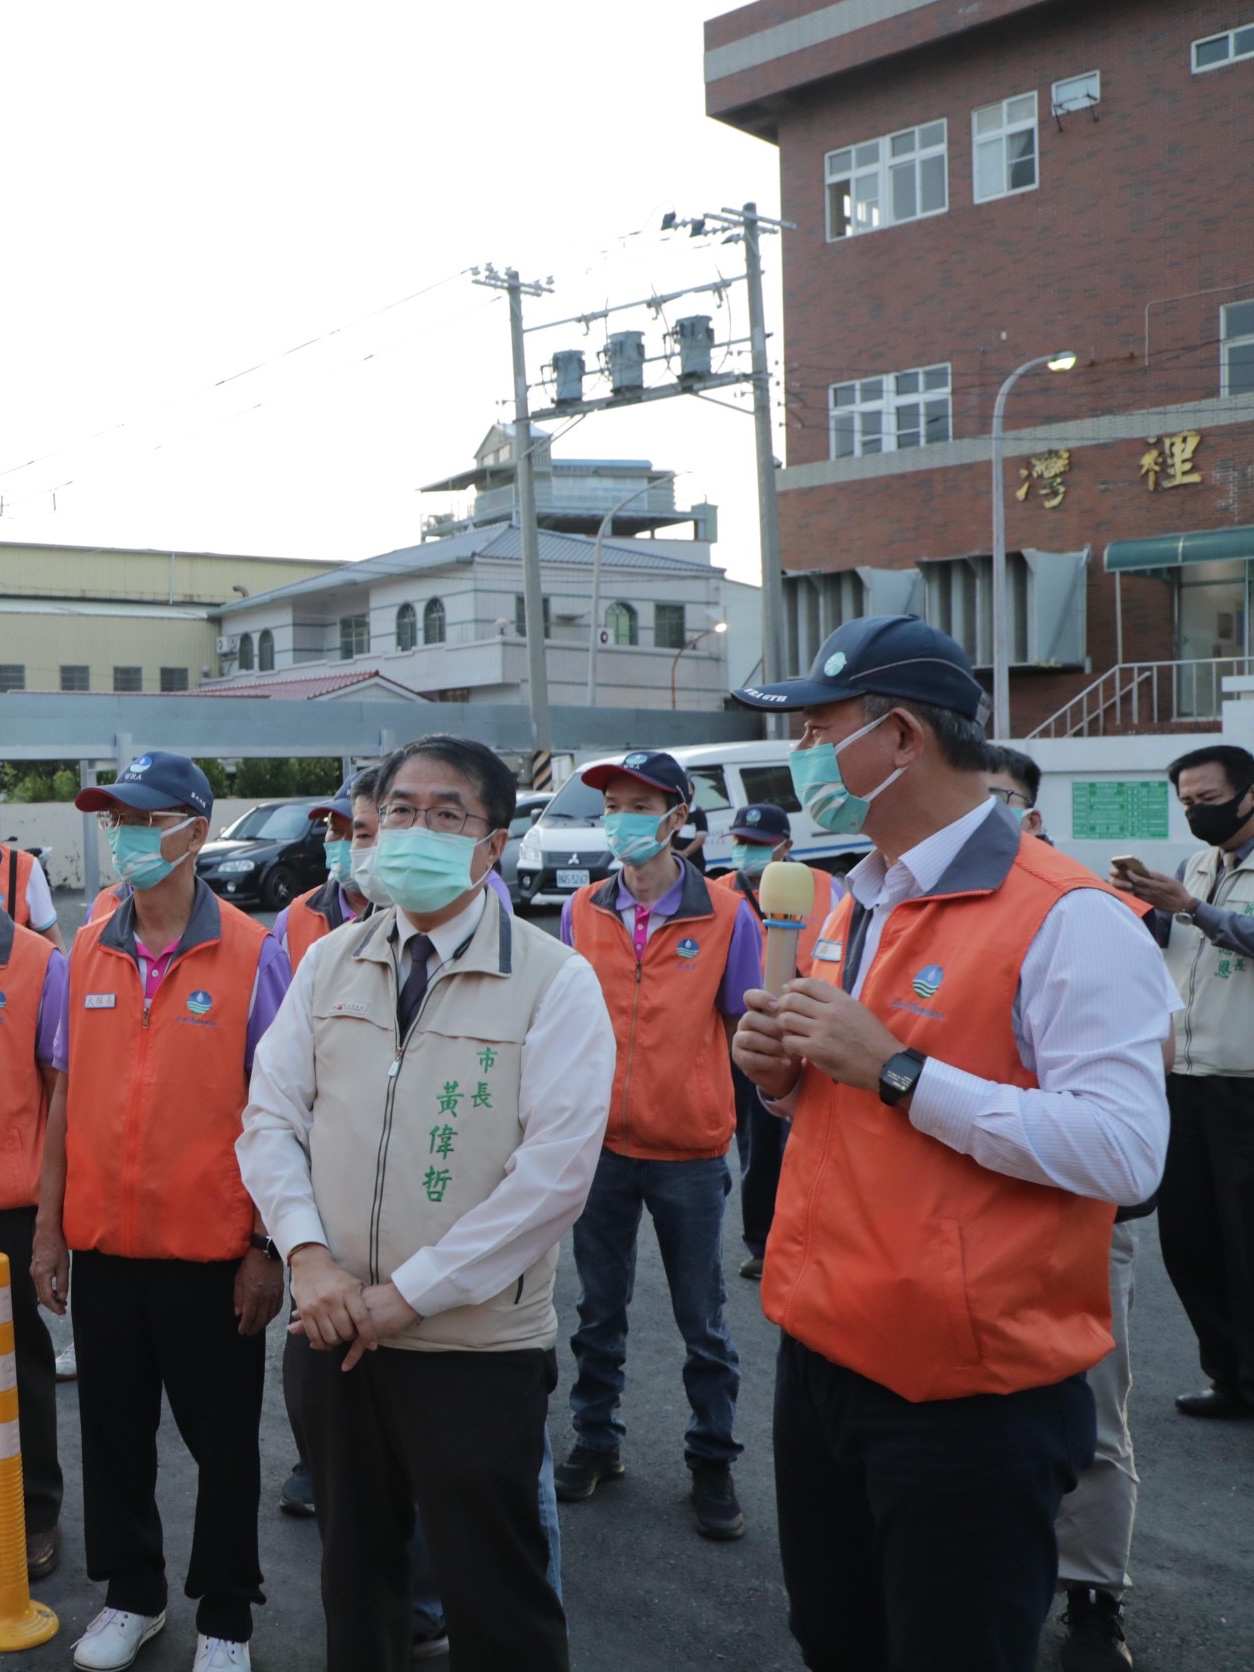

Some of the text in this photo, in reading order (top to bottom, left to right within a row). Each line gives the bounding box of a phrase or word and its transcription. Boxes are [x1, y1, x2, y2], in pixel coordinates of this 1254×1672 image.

[124, 773, 142, 781] WRA
[470, 1046, 499, 1109] 市長
[422, 1081, 465, 1203] 黃偉哲
